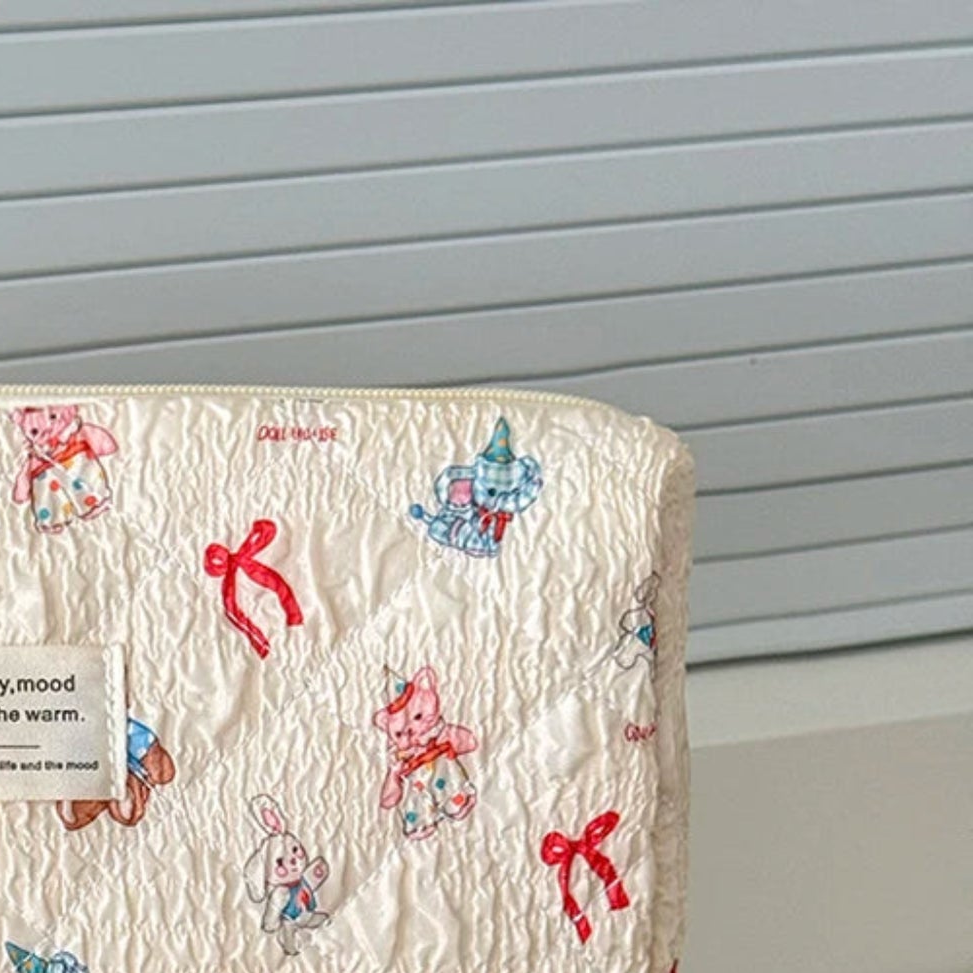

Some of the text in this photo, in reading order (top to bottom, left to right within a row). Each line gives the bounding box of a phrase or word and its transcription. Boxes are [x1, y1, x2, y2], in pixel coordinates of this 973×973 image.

[25, 708, 86, 723] warm.
[20, 760, 42, 772] and
[44, 760, 63, 772] the
[65, 760, 100, 772] mood
